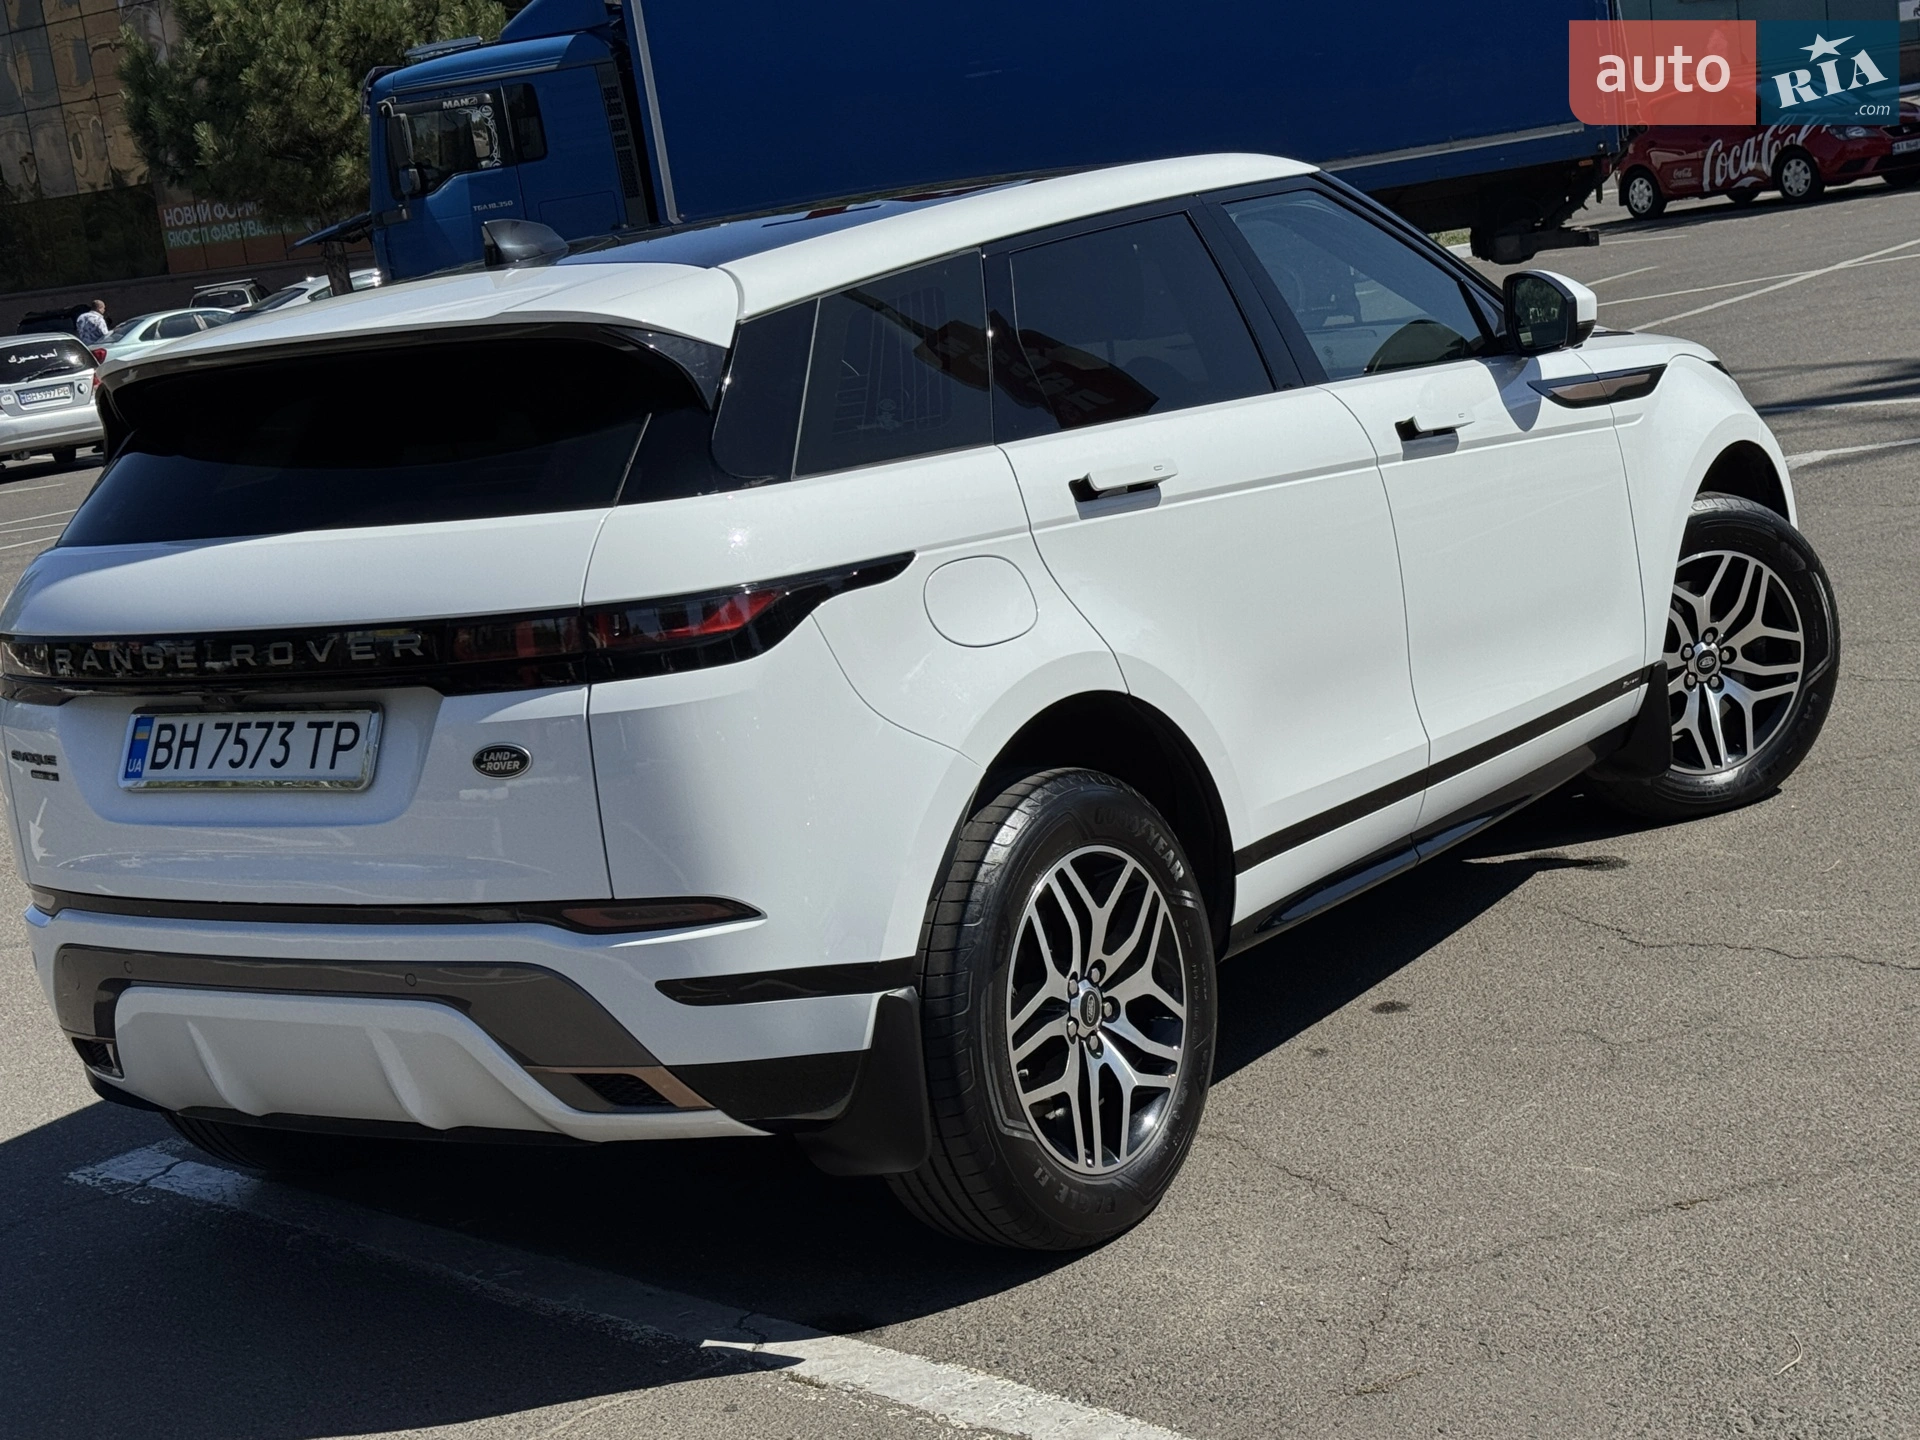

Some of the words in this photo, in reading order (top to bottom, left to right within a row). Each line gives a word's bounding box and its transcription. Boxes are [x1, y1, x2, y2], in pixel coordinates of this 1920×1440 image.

[442, 98, 470, 110] MAN
[1703, 113, 1832, 193] Coca-Col
[163, 200, 213, 228] НОВИЙ
[213, 200, 264, 221] ФОРМ
[55, 644, 199, 674] RANGE
[230, 633, 425, 667] ROVER
[127, 757, 142, 774] UA
[149, 722, 204, 771] BH
[207, 721, 296, 771] 7573
[307, 720, 361, 771] TP
[483, 751, 511, 762] LAND
[486, 760, 521, 771] ROVER
